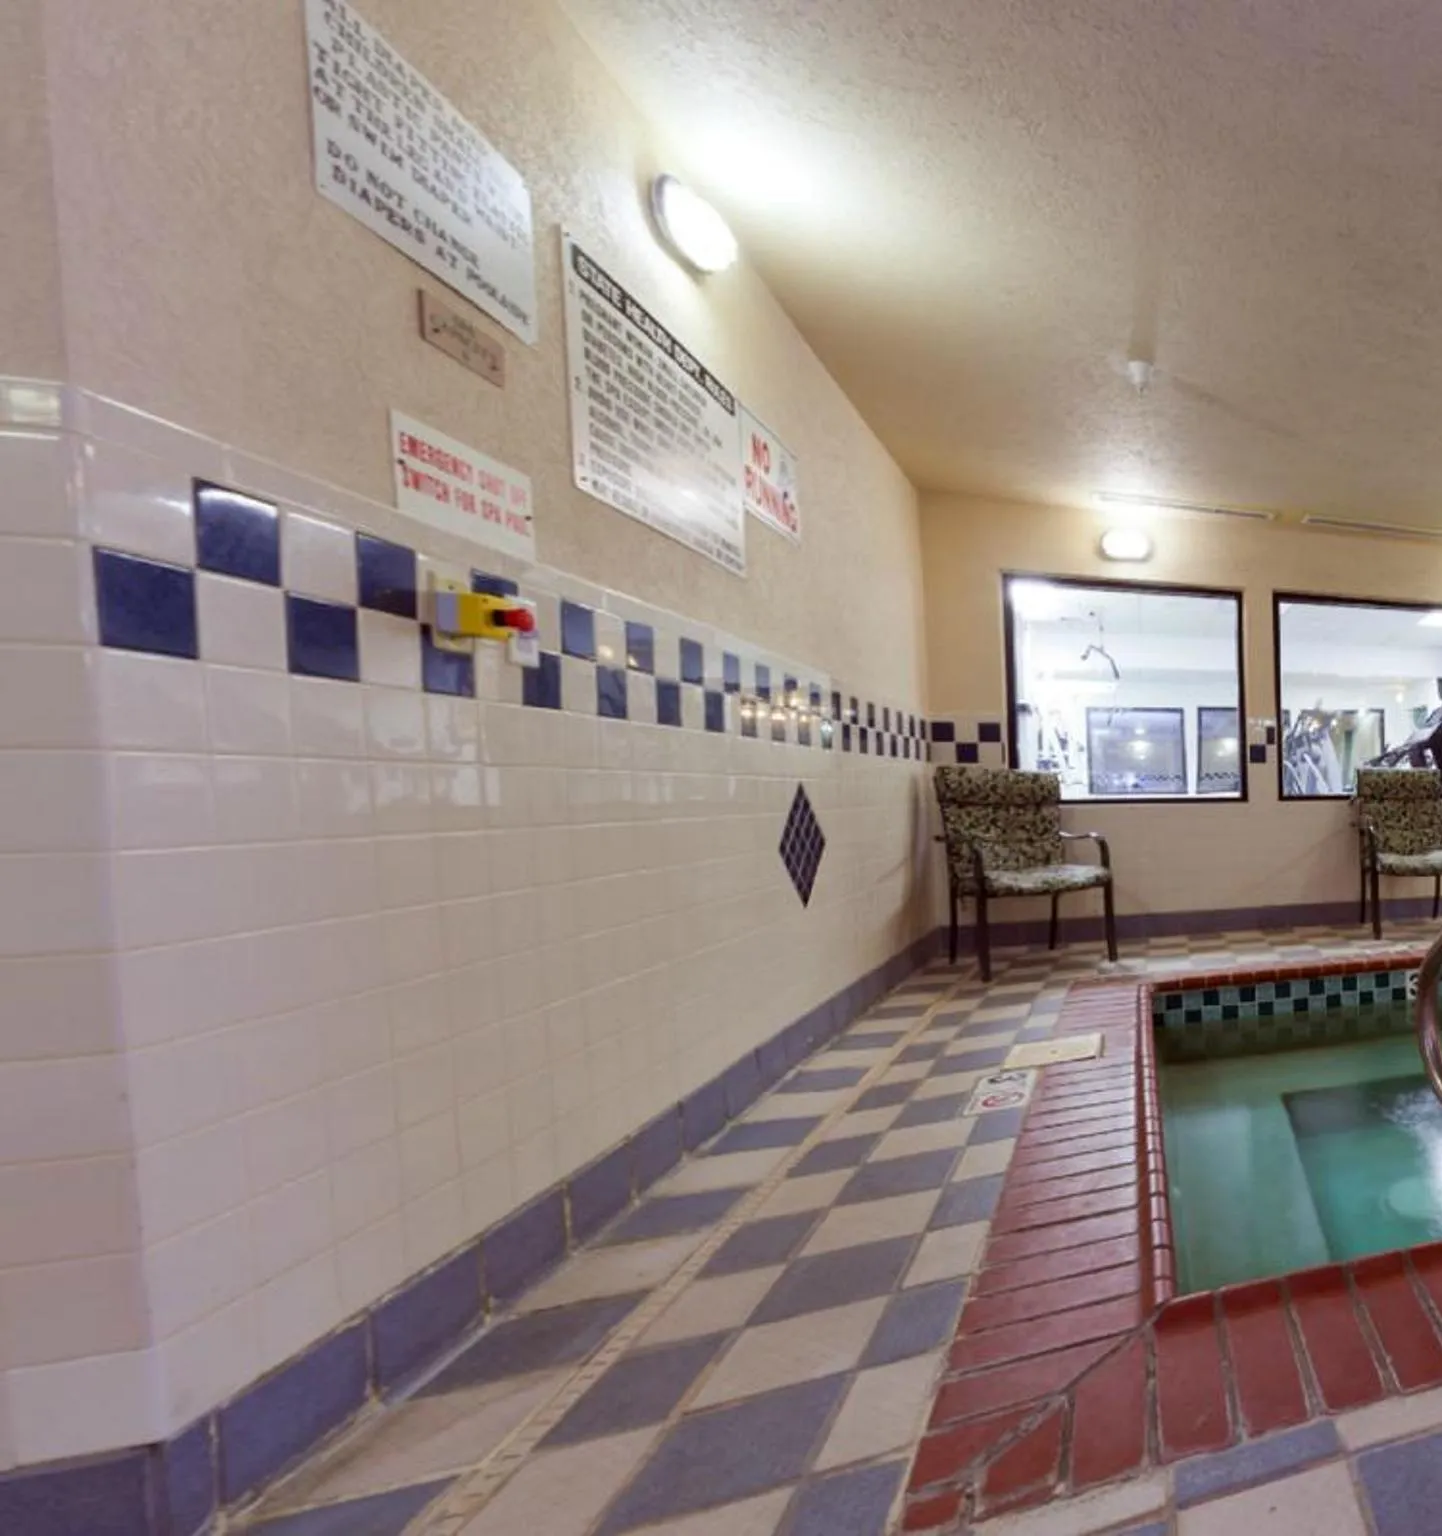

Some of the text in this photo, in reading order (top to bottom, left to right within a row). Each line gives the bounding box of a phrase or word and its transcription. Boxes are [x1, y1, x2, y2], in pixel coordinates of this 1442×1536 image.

[326, 135, 479, 270] DO NOT CHANGE
[331, 161, 425, 248] DIAPERS
[434, 240, 458, 272] AT
[578, 254, 622, 311] STATE
[399, 429, 473, 485] EMERGENCY
[752, 433, 770, 474] NO
[402, 463, 449, 505] SWITCH
